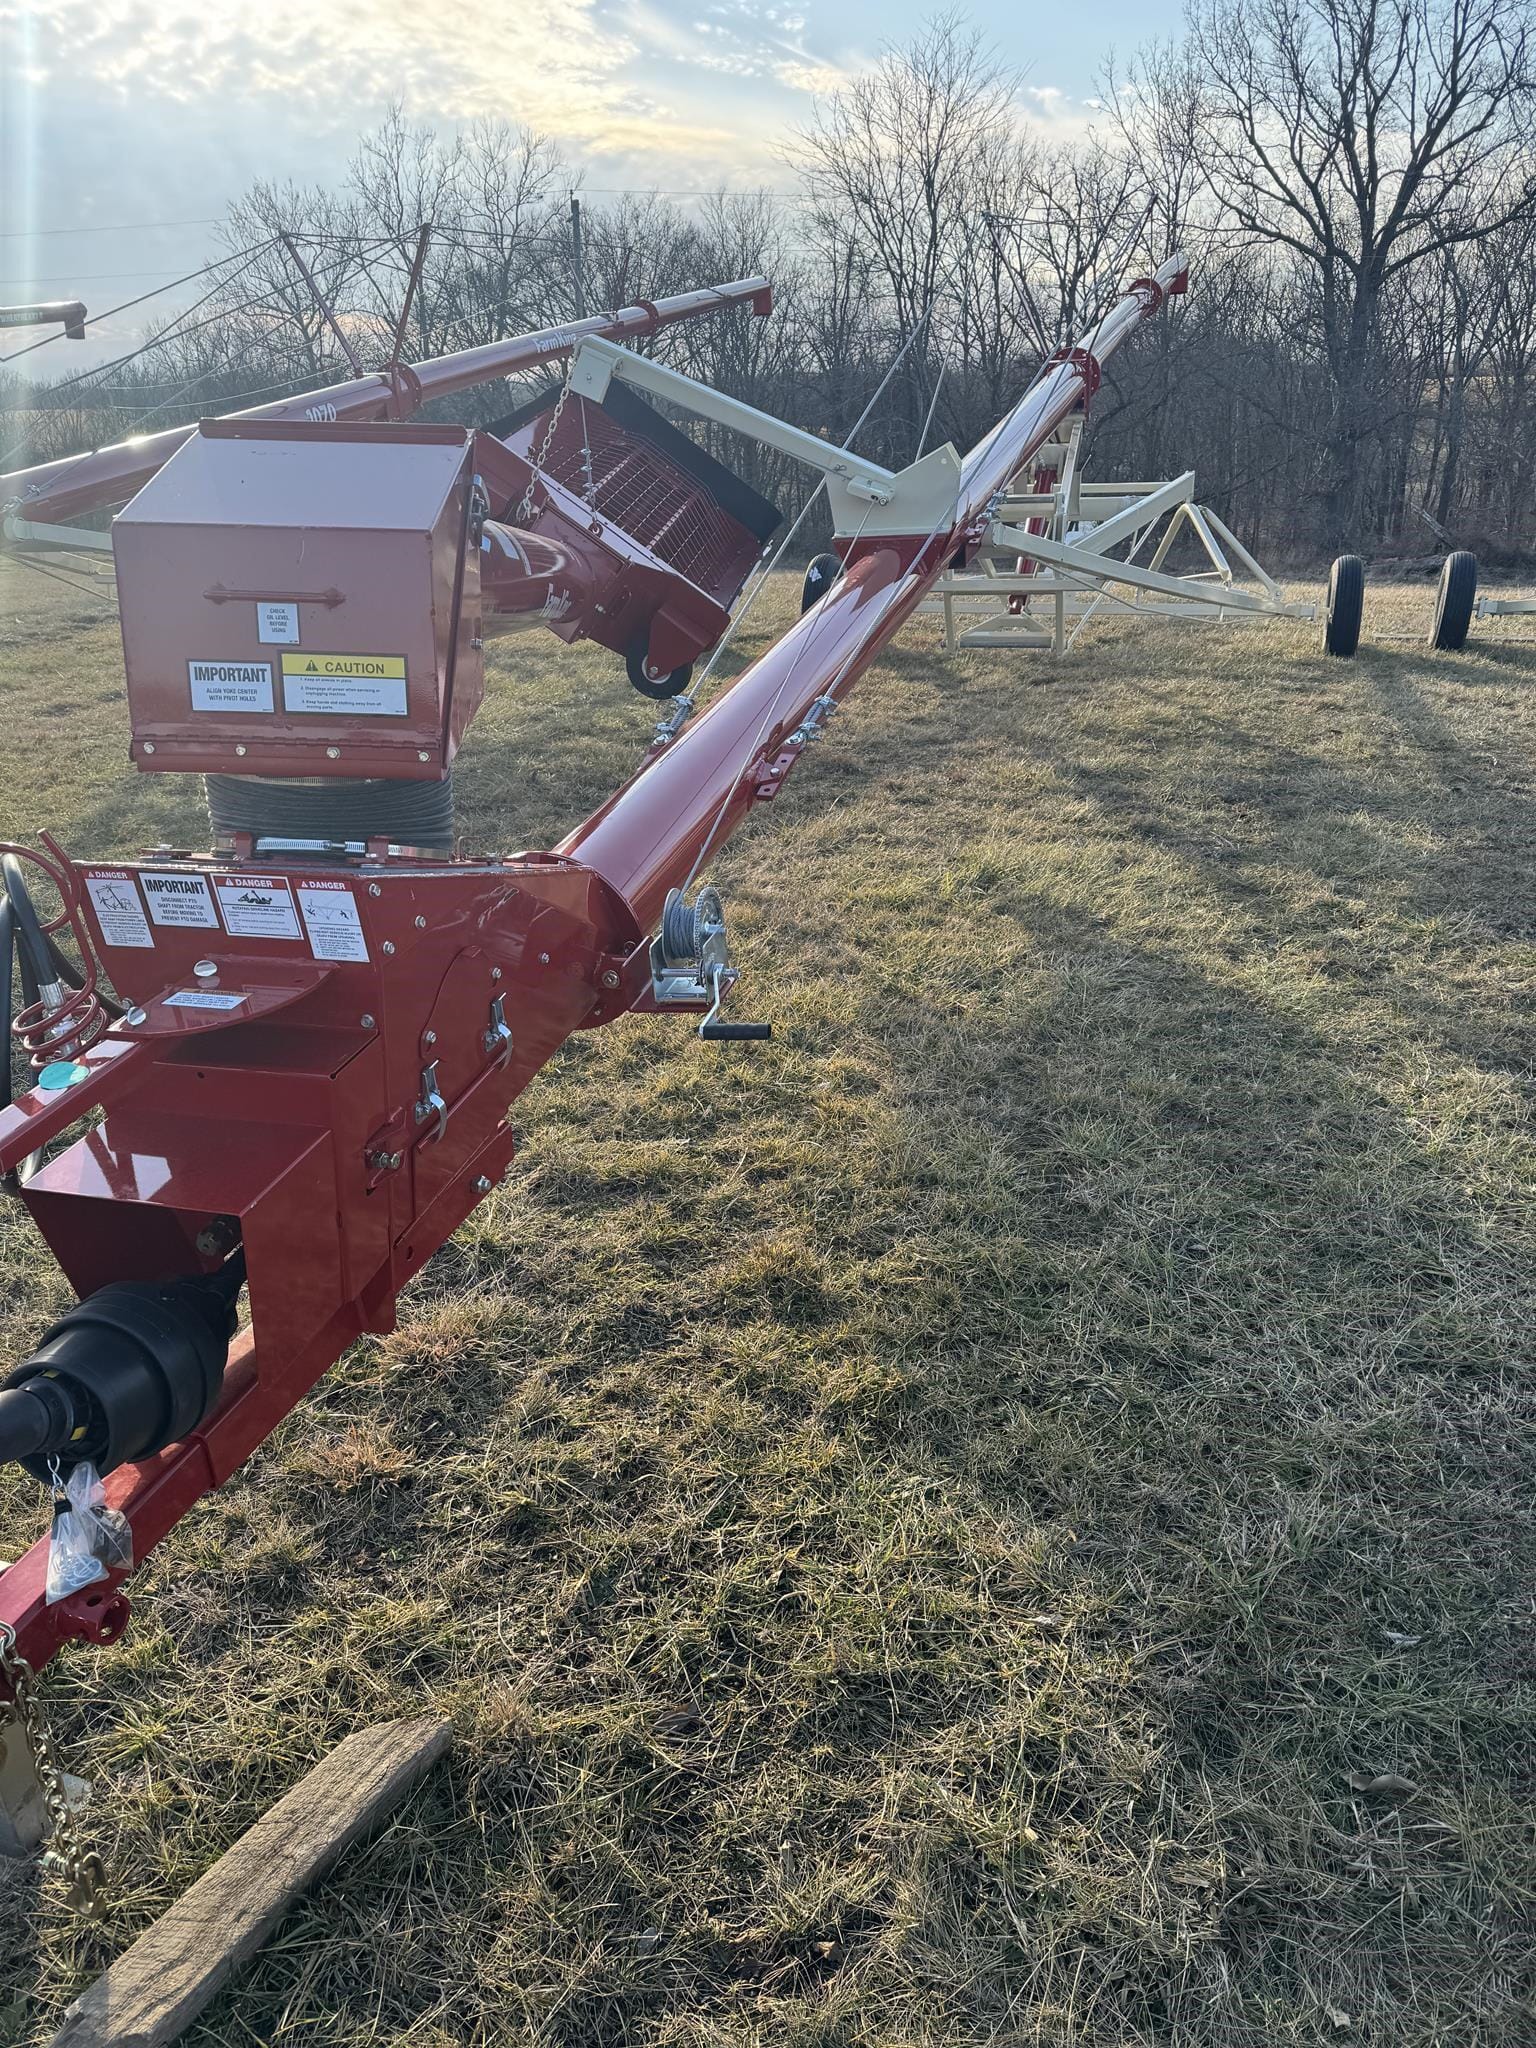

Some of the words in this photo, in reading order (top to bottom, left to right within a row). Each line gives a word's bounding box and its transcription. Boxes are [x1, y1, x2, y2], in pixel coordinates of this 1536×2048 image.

[324, 662, 385, 674] CAUTION
[194, 666, 268, 682] IMPORTANT
[95, 871, 128, 879] DANGER
[144, 880, 205, 894] IMPORTANT
[235, 879, 273, 888] DANGER
[309, 881, 346, 890] DANGER
